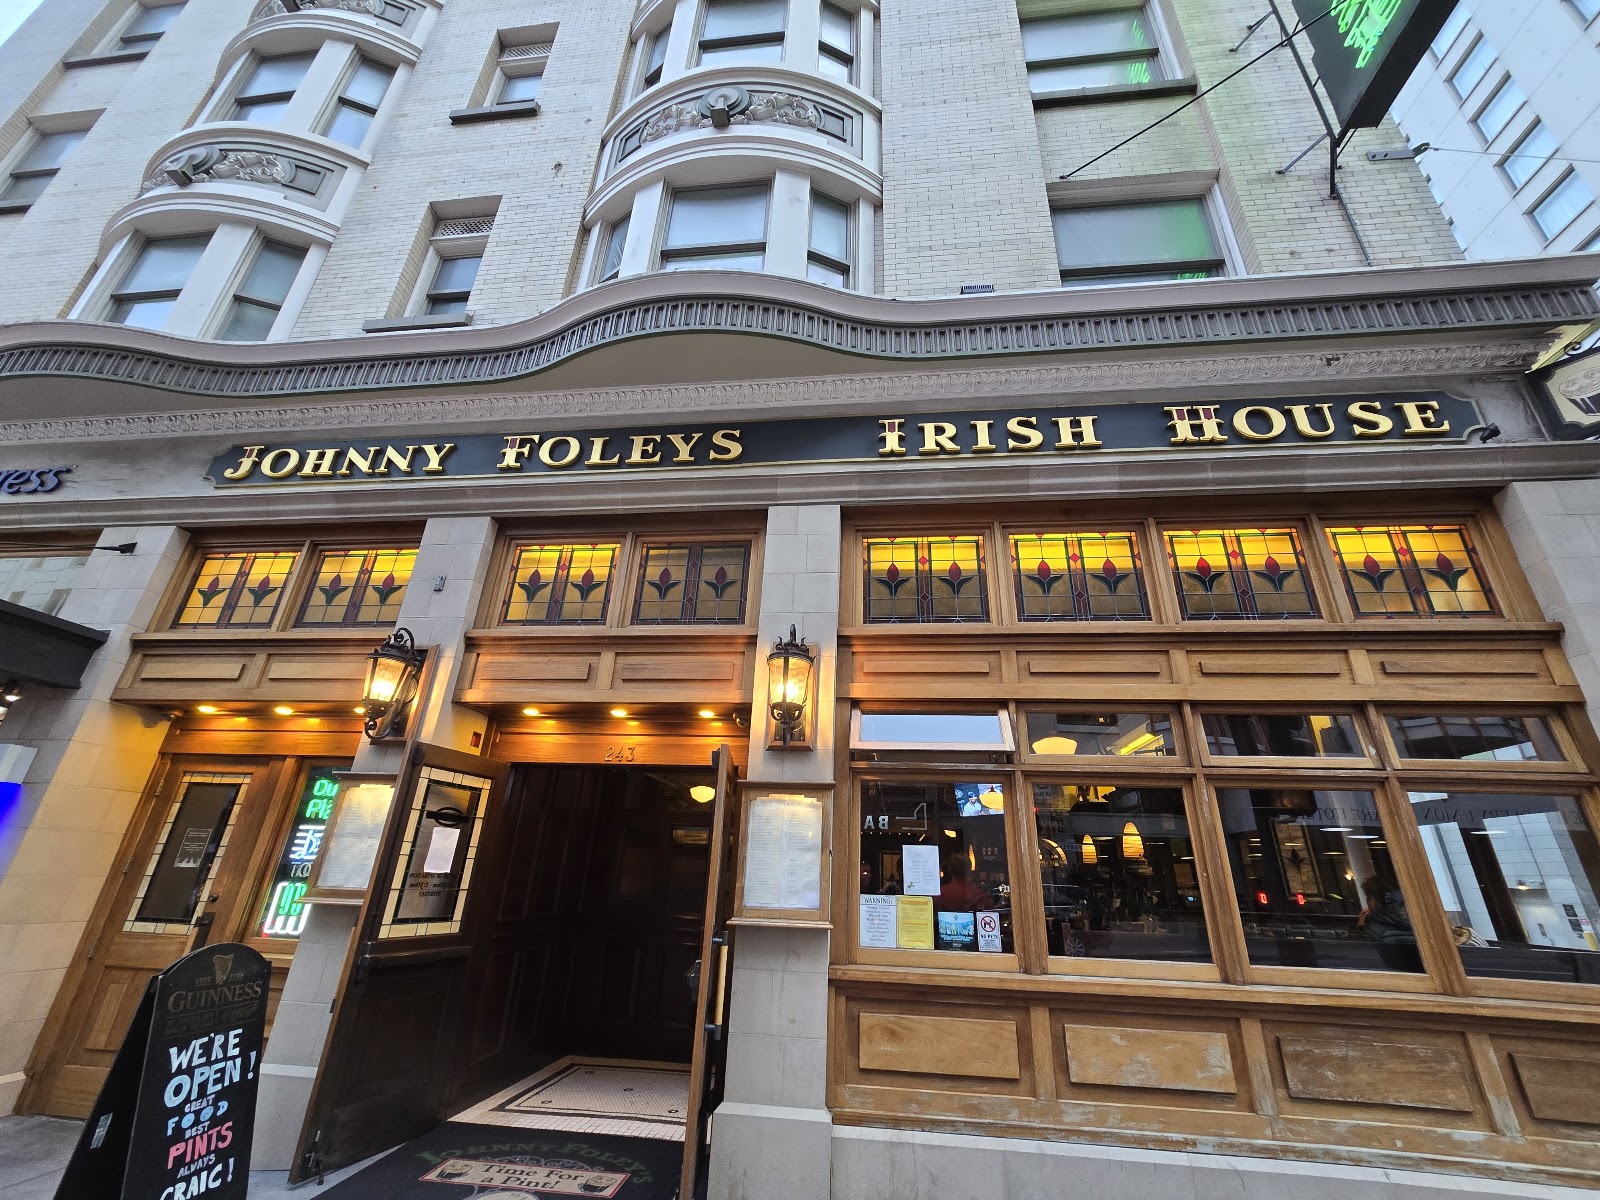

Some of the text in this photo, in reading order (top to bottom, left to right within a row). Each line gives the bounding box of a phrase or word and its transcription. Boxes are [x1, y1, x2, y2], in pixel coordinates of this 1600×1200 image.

[224, 400, 1450, 480] JOHNNY FOLEYS IRISH HOUSE
[604, 745, 636, 763] 243
[864, 897, 893, 905] WARNING:
[167, 981, 262, 1013] GUINNESS
[168, 1028, 243, 1074] WE'RE
[184, 1094, 216, 1113] GREAT
[166, 1100, 229, 1137] FOOD
[184, 1120, 211, 1140] BEST
[167, 1121, 233, 1170] PINTS
[176, 1153, 216, 1179] ALWAYS
[480, 1162, 586, 1182] Time For
[481, 1176, 560, 1190] a Pint!
